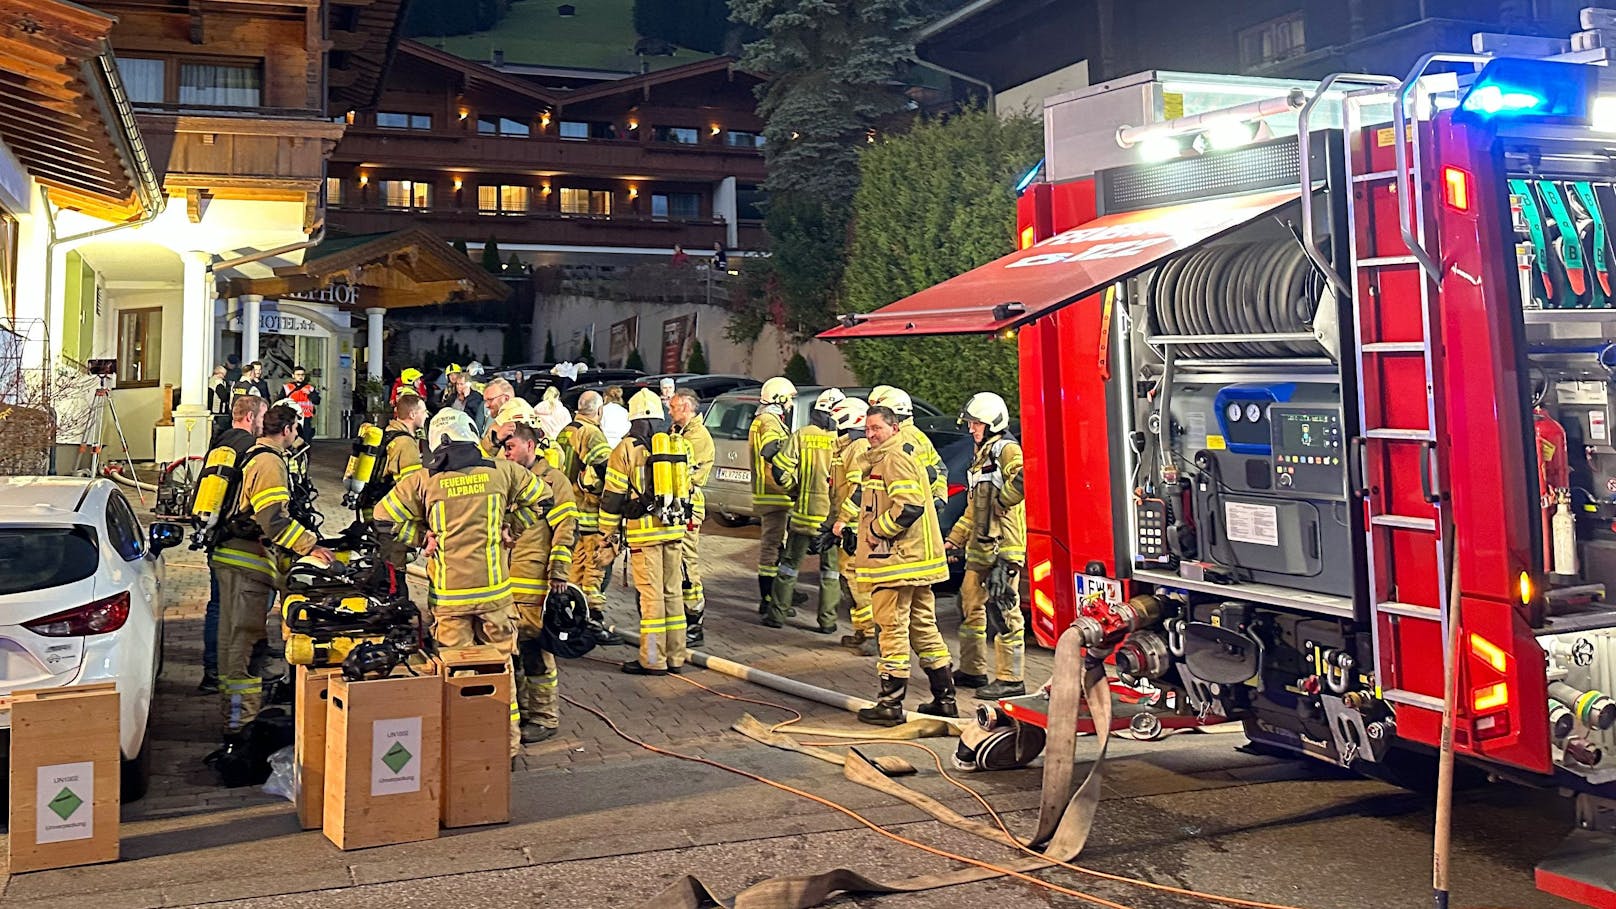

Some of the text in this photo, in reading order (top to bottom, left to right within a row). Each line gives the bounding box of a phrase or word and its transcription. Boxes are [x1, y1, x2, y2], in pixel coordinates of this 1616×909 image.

[1548, 191, 1558, 205] B
[1585, 193, 1594, 206] B
[1569, 245, 1578, 260] B
[281, 283, 360, 304] PHOF
[440, 473, 490, 488] FEUERWEHR
[447, 484, 486, 497] ALPBACH
